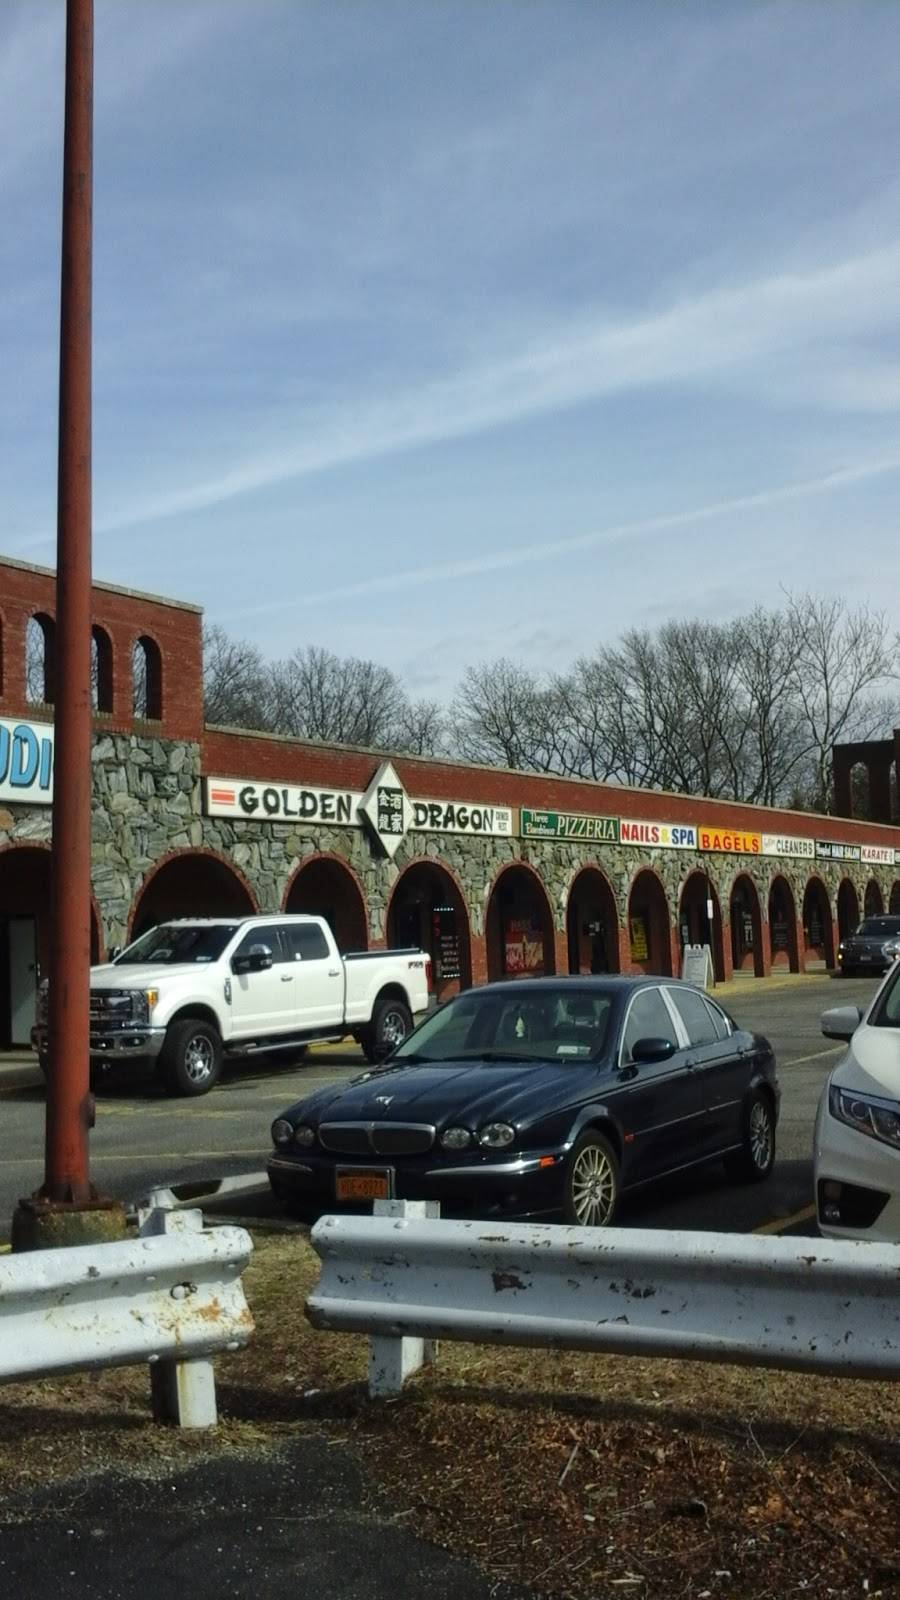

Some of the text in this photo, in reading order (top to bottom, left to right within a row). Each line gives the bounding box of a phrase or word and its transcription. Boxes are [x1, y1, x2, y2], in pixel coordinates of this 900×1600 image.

[239, 786, 494, 831] GOLDEN DRAGON
[556, 815, 616, 839] PIZZERIA
[621, 823, 694, 846] NAILS & SPA
[702, 834, 759, 853] BAGELS
[776, 839, 813, 856] CLEANERS
[862, 848, 889, 862] KARATE
